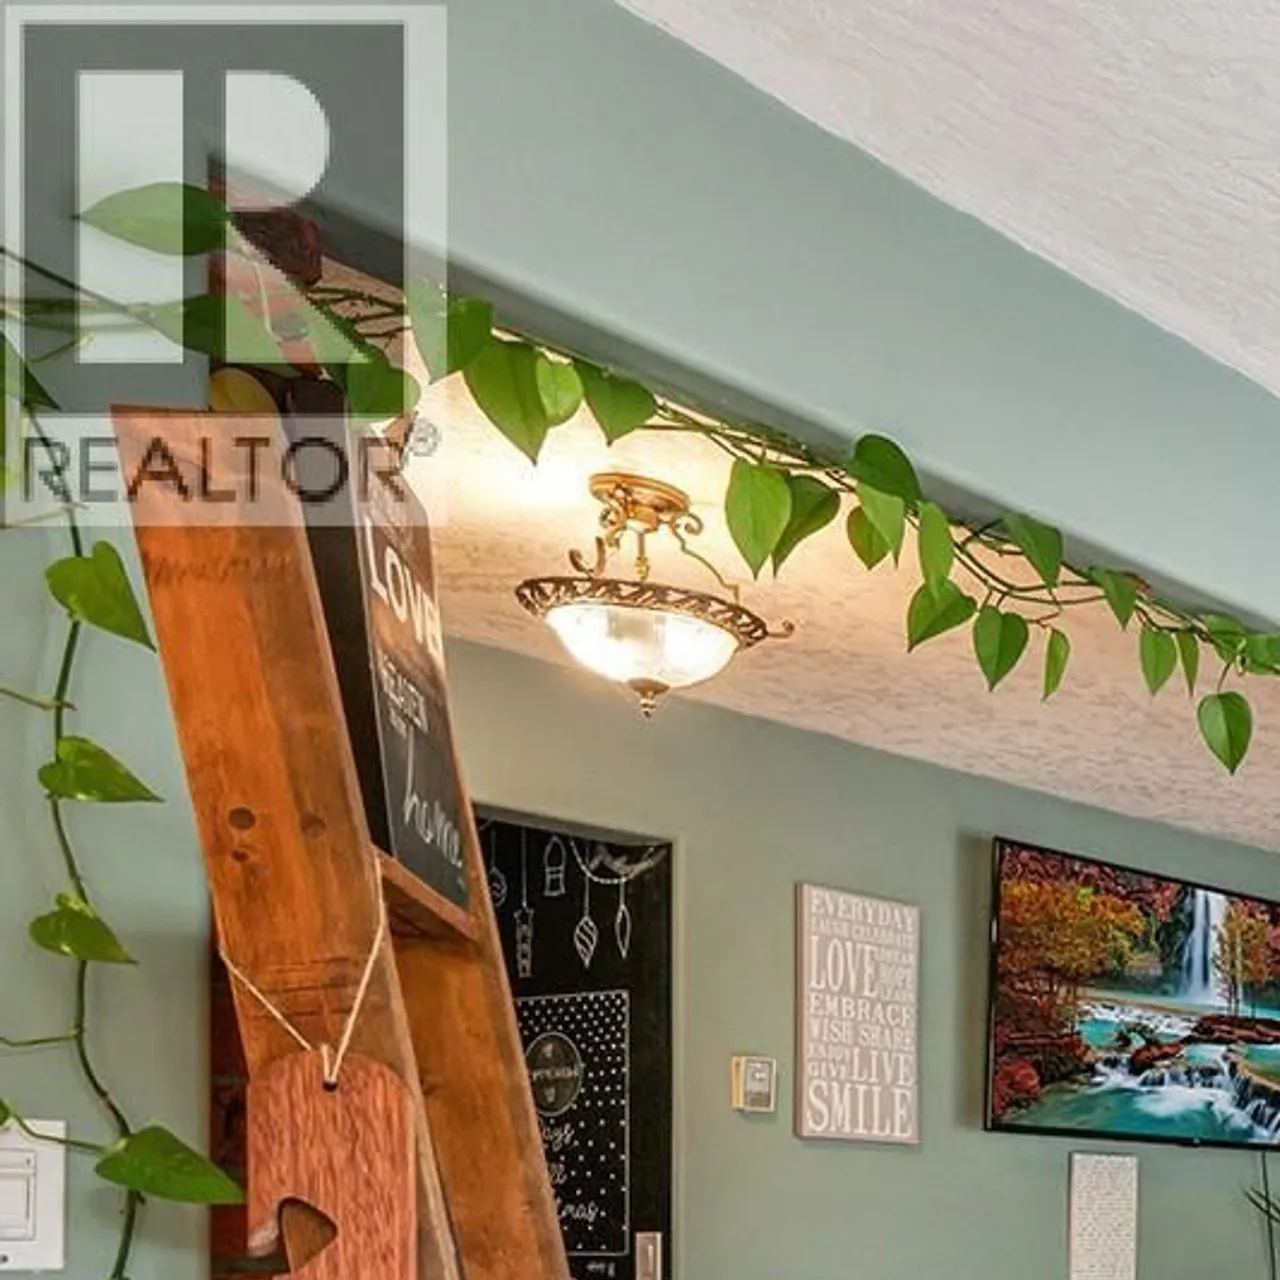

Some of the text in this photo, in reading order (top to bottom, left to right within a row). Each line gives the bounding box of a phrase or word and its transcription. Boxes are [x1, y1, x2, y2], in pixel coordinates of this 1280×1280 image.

[363, 514, 445, 672] LOVE
[809, 935, 878, 998] LOVE
[852, 1046, 914, 1086] LIVE
[806, 1079, 912, 1137] SMILE
